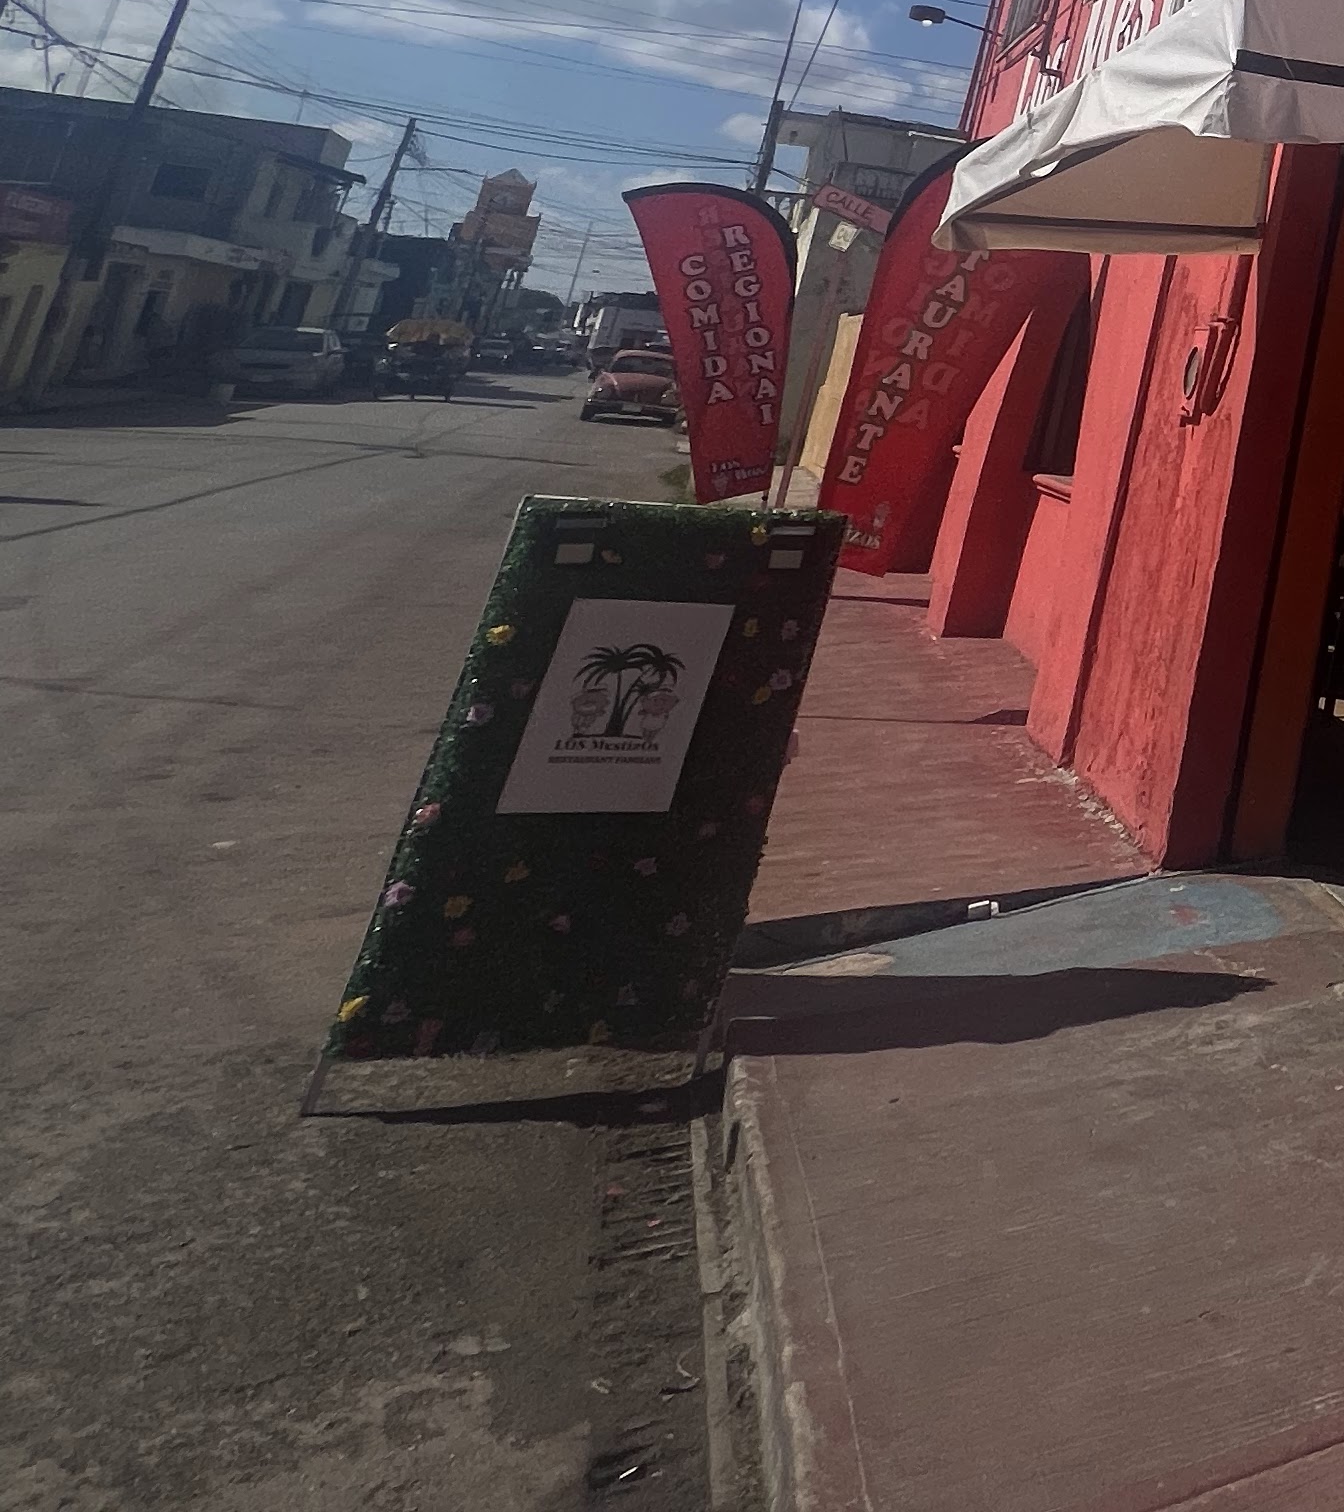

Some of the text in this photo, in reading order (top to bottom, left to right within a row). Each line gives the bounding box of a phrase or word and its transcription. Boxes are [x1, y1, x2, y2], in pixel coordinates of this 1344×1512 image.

[826, 191, 876, 221] CALLE
[681, 255, 735, 405] COMIDA
[837, 250, 990, 485] TAURANTE
